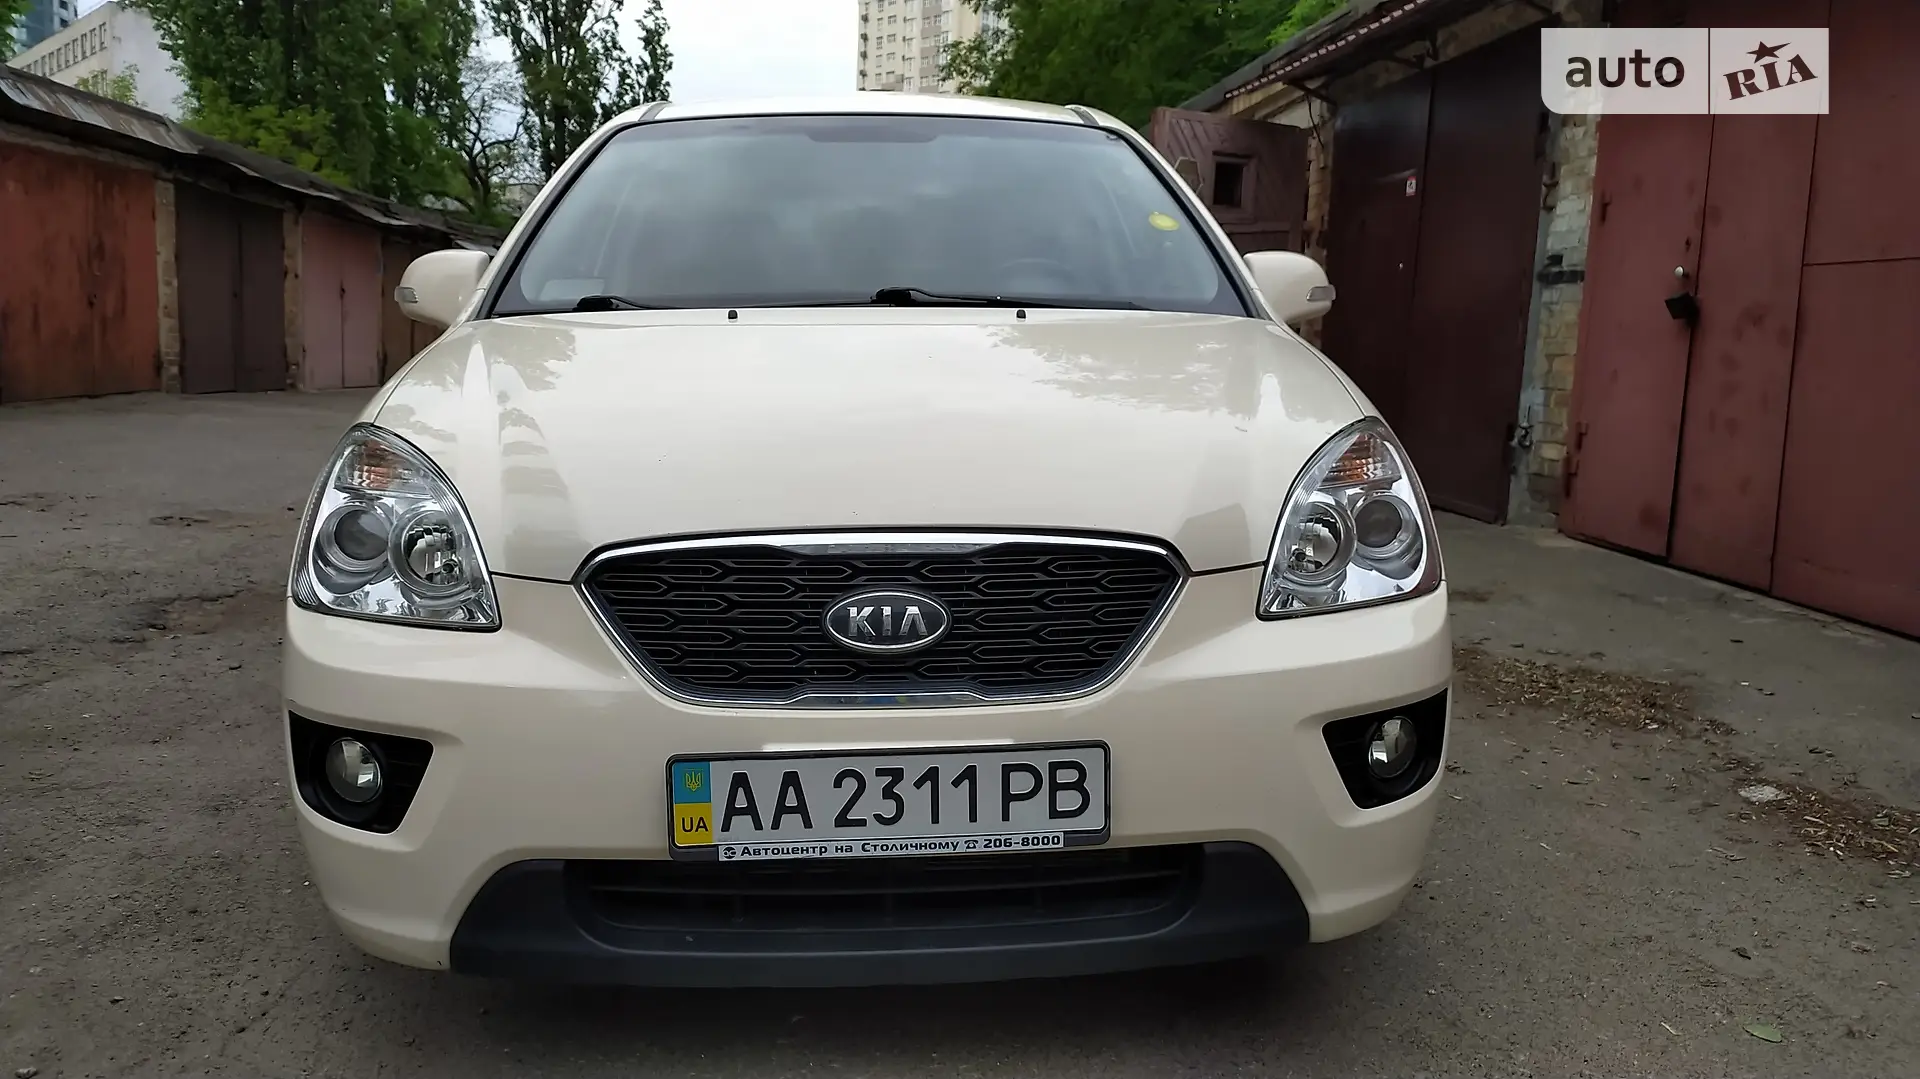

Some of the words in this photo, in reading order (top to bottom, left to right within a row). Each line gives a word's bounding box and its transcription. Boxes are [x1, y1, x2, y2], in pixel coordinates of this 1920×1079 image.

[846, 605, 928, 636] KIA
[720, 770, 814, 833] AA
[832, 764, 978, 828] 2311
[1000, 760, 1092, 822] PB
[681, 816, 709, 833] UA
[740, 844, 828, 857] Автоцентр
[834, 844, 854, 854] на
[861, 840, 960, 853] Столичному
[983, 835, 1061, 849] 206-8000
